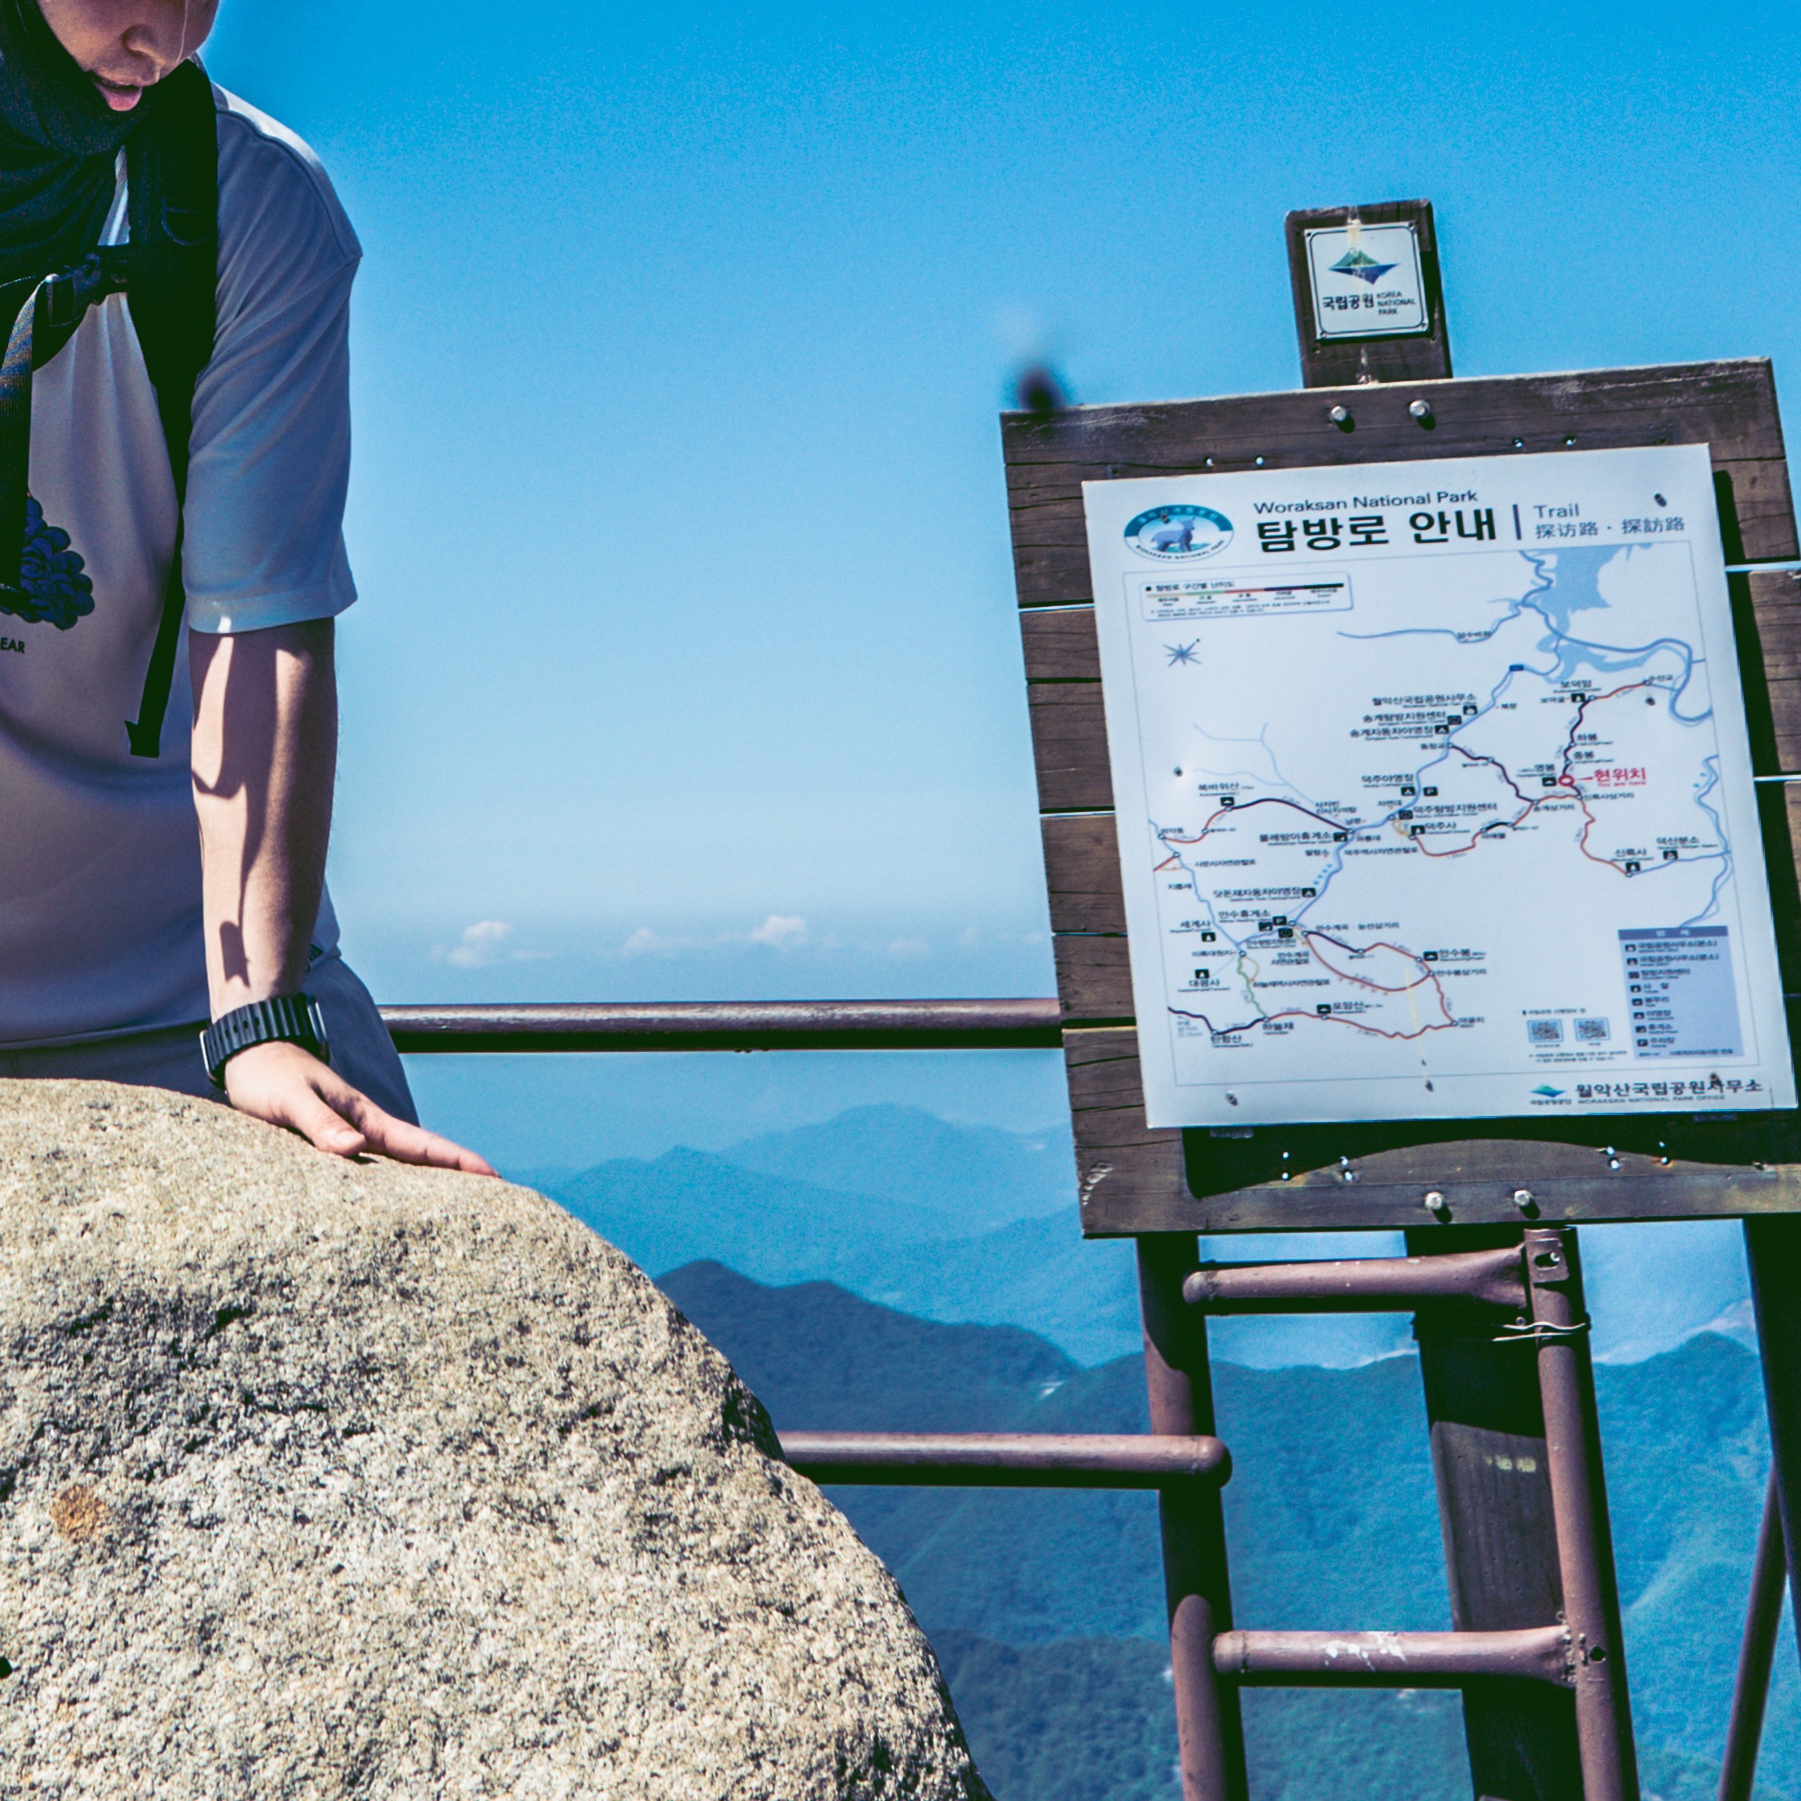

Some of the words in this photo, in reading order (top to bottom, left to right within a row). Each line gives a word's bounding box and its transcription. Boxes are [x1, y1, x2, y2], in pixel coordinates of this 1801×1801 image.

[1322, 293, 1374, 310] 국립공원
[1376, 290, 1402, 299] KOREA
[1377, 298, 1417, 307] NATIONAL
[1253, 498, 1347, 515] Woraksan
[1353, 492, 1431, 509] National
[1437, 488, 1478, 504] Park
[1533, 502, 1580, 520] Trail
[1257, 515, 1389, 553] 탐방로
[1409, 507, 1497, 544] 안내
[1534, 521, 1599, 540] 探访路
[1621, 515, 1686, 535] 探訪路
[1593, 766, 1647, 783] 현위치
[1576, 1078, 1763, 1098] 월악산국립공원사무소
